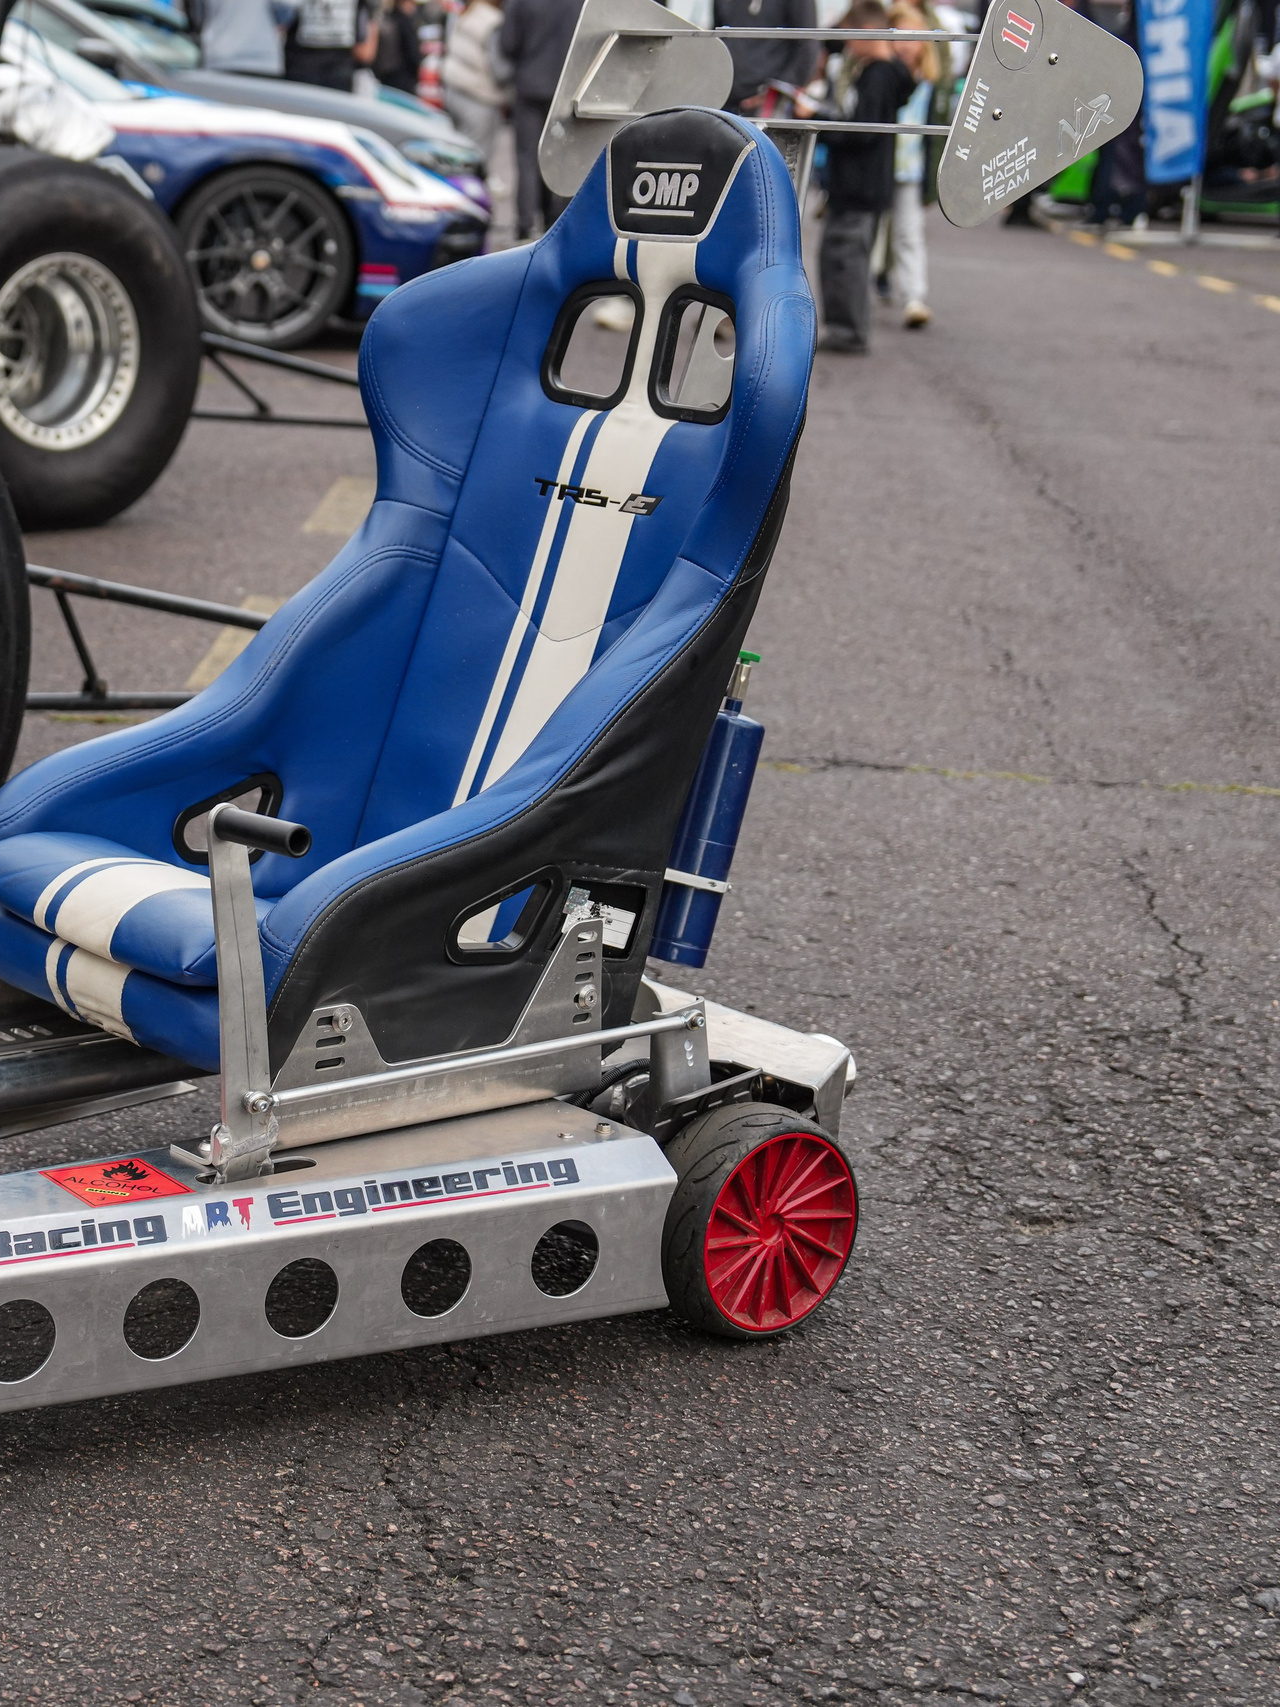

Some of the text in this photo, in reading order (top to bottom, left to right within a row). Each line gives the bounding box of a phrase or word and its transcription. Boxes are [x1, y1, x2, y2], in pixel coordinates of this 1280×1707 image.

[1001, 10, 1035, 52] 11
[963, 78, 990, 133] НАЙТ
[981, 137, 1029, 177] NIGHT
[982, 148, 1037, 192] RACER
[632, 171, 700, 206] OMP
[983, 168, 1030, 204] TEAM
[63, 1176, 162, 1194] ALCOHOL
[182, 1197, 253, 1238] ART
[266, 1158, 580, 1217] Engineering
